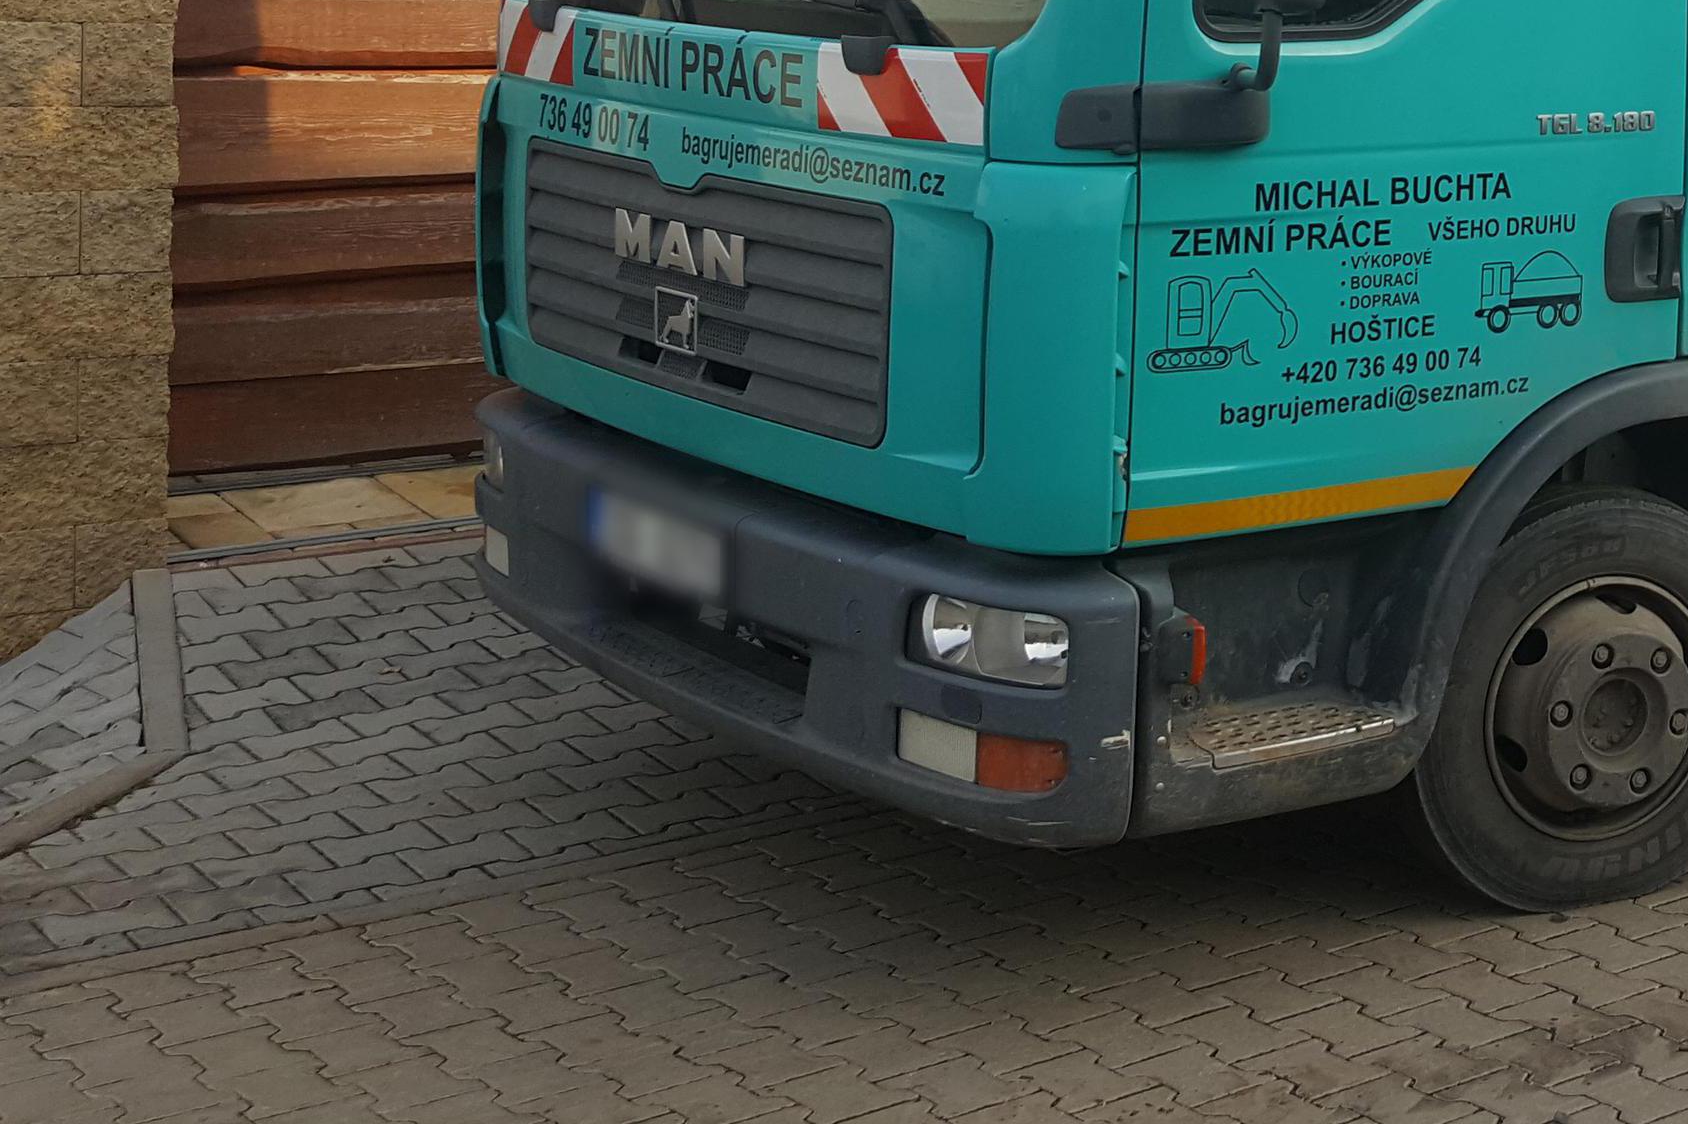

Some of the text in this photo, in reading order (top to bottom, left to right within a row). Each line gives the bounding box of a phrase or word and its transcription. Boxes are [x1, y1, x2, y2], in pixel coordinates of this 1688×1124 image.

[583, 26, 803, 108] ZEMNÍ PRÁCE
[539, 93, 649, 151] 736 49 00 74
[1537, 110, 1655, 135] TGL 8.180
[681, 126, 945, 196] bagrujemeradi@seznam.cz
[1255, 172, 1512, 212] MICHAL BUCHTA
[615, 207, 745, 287] MAN
[1169, 213, 1576, 257] ZEMNÍ PRÁCE VŠEHO DRUHU
[1351, 247, 1432, 270] VÝKOPOVÉ
[1351, 268, 1419, 290] BOURACÍ
[1350, 291, 1420, 310] DOPRAVA
[1330, 314, 1436, 345] HOŠTICE
[1281, 345, 1482, 384] +420 736 49 00 74
[1219, 376, 1529, 428] bagrujemeradi@seznam.cz
